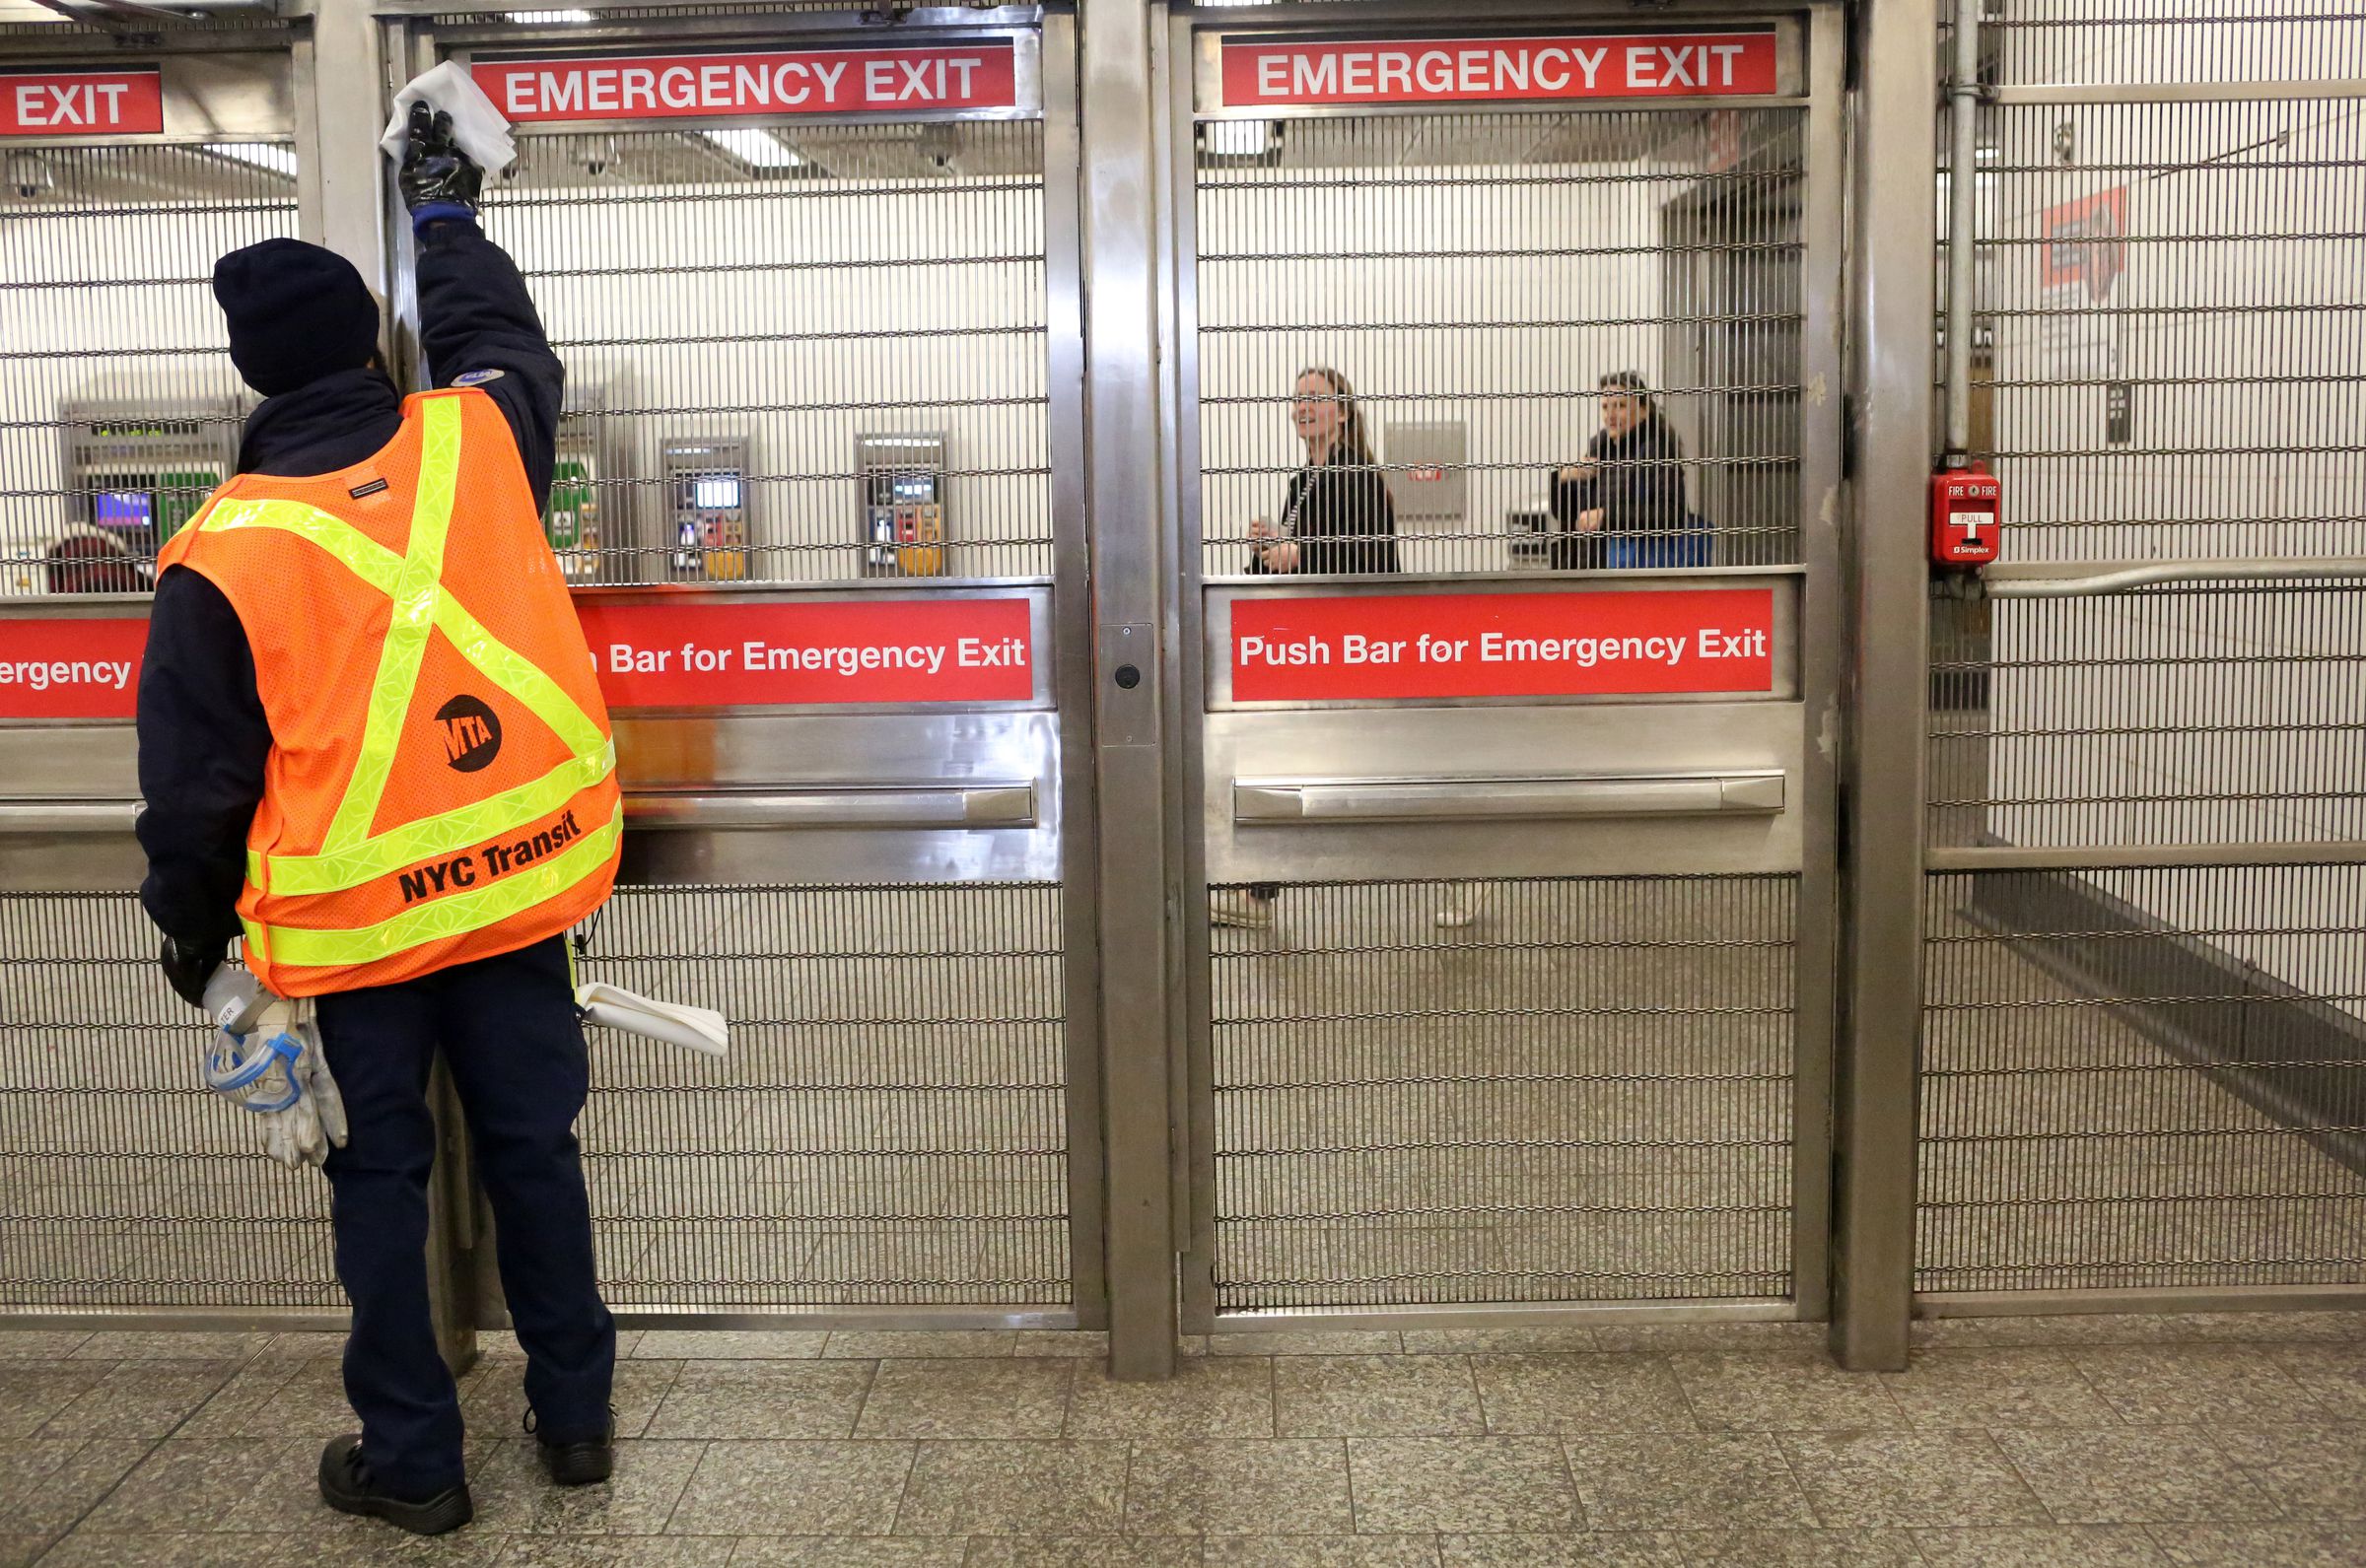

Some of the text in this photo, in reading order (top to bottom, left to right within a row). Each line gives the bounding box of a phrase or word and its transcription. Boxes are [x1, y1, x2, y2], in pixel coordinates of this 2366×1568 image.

[506, 57, 982, 113] EMERGENCY EXIT
[1257, 44, 1744, 96] EMERGENCY EXIT
[16, 84, 128, 125] EXIT
[1948, 486, 1996, 496] FIRE FIRE
[1961, 513, 1983, 523] PULL
[1961, 546, 1989, 555] Simplex
[609, 644, 671, 673] Bar
[681, 643, 731, 672] for
[743, 642, 945, 676] Emergency
[957, 638, 1026, 667] Exit
[1239, 628, 1766, 667] Push Bar for Emergency Exit
[0, 661, 131, 690] ergency
[440, 715, 493, 762] MTA
[398, 809, 582, 903] NYC Transit
